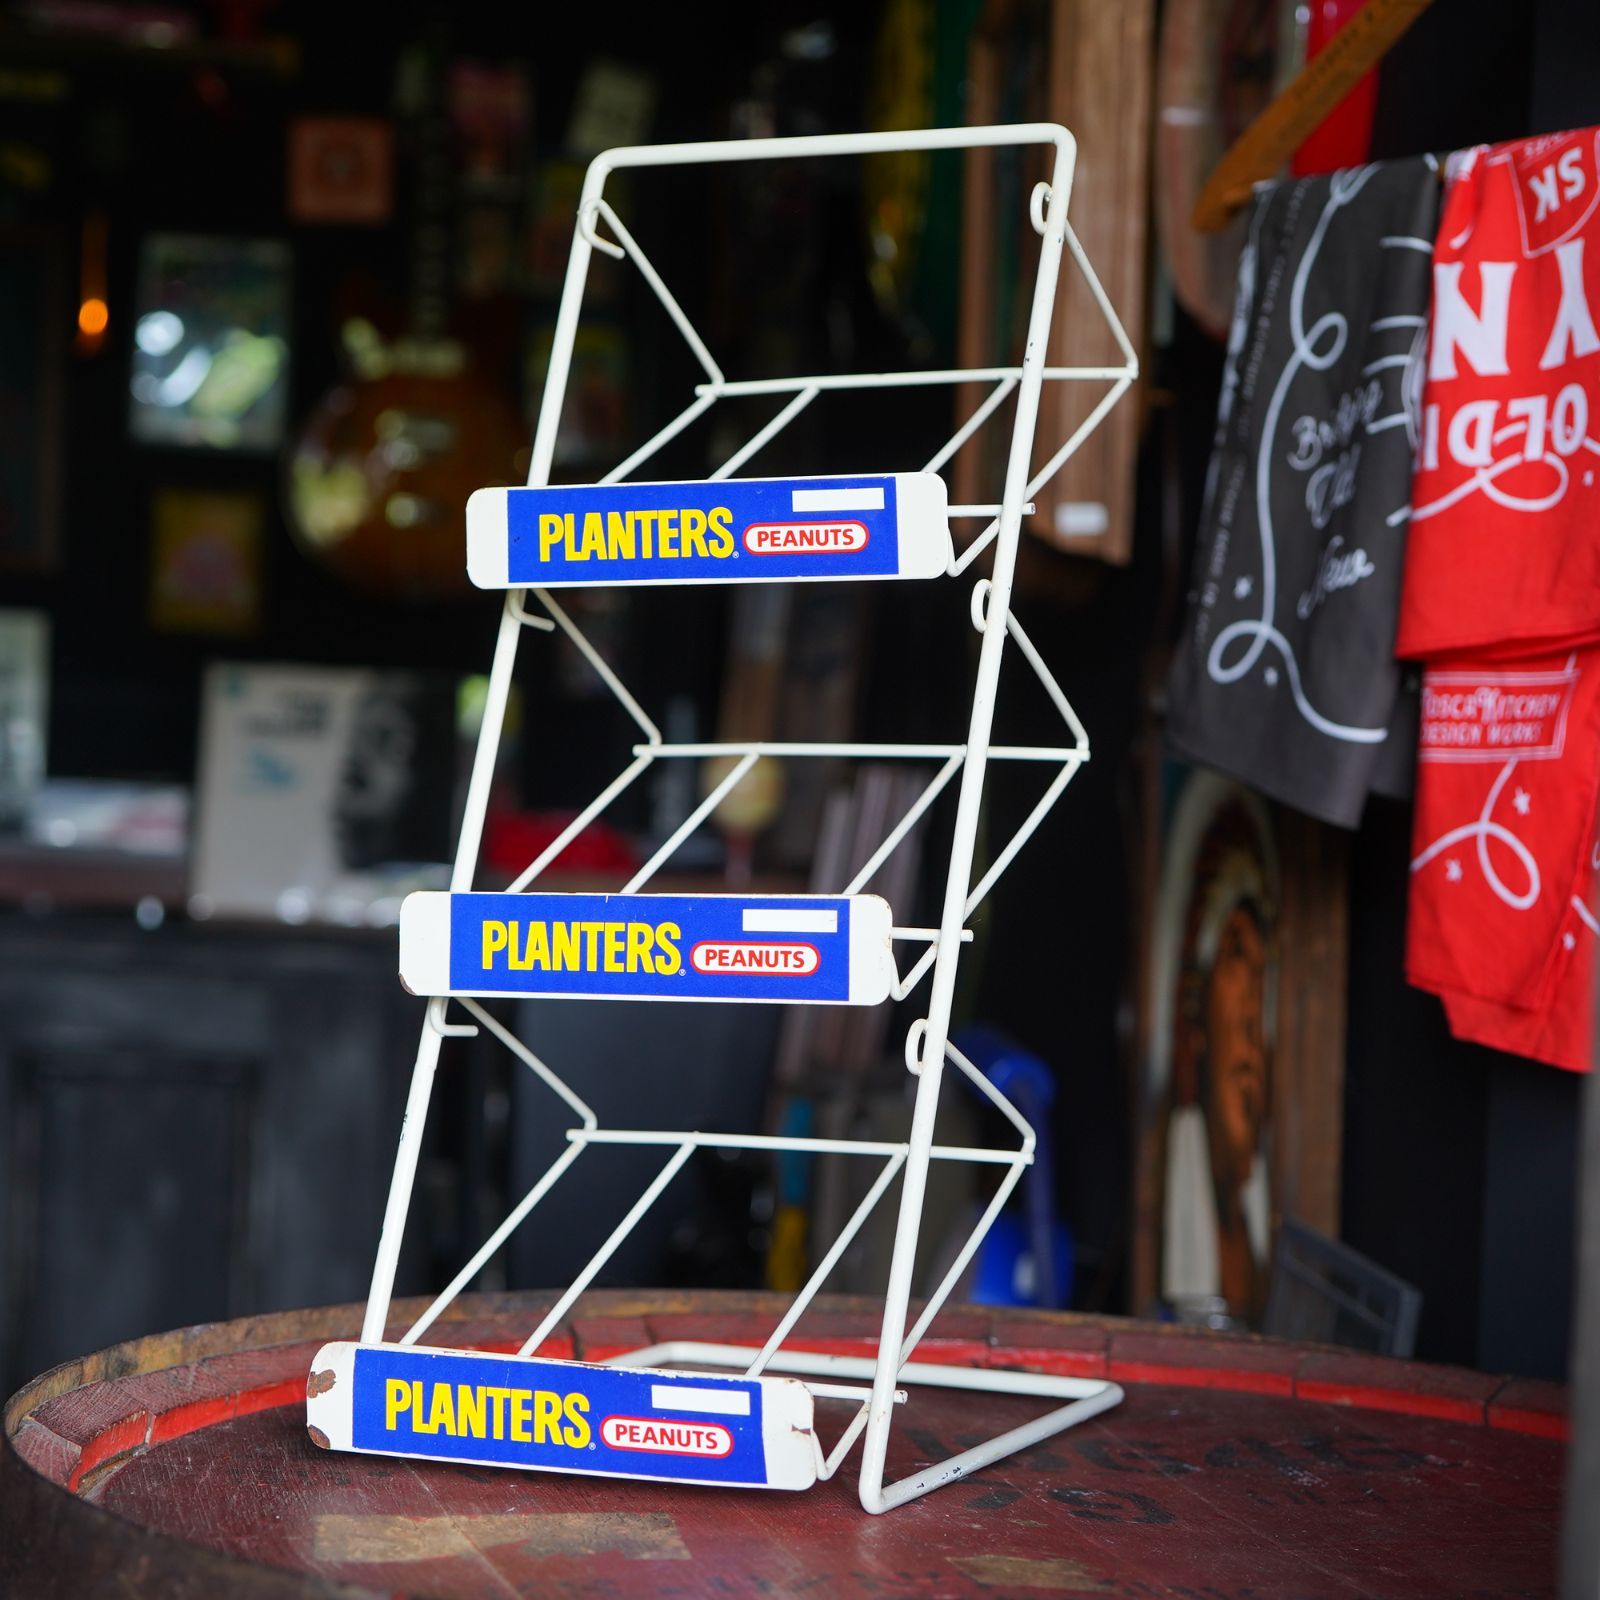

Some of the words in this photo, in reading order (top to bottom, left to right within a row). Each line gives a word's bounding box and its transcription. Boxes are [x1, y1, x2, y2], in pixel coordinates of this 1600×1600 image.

[538, 506, 735, 562] PLANTERS
[757, 528, 854, 548] PEANUTS
[481, 919, 682, 976] PLANTERS
[704, 949, 805, 969] PEANUTS
[384, 1378, 591, 1449] PLANTERS
[614, 1423, 719, 1450] PEANUTS
